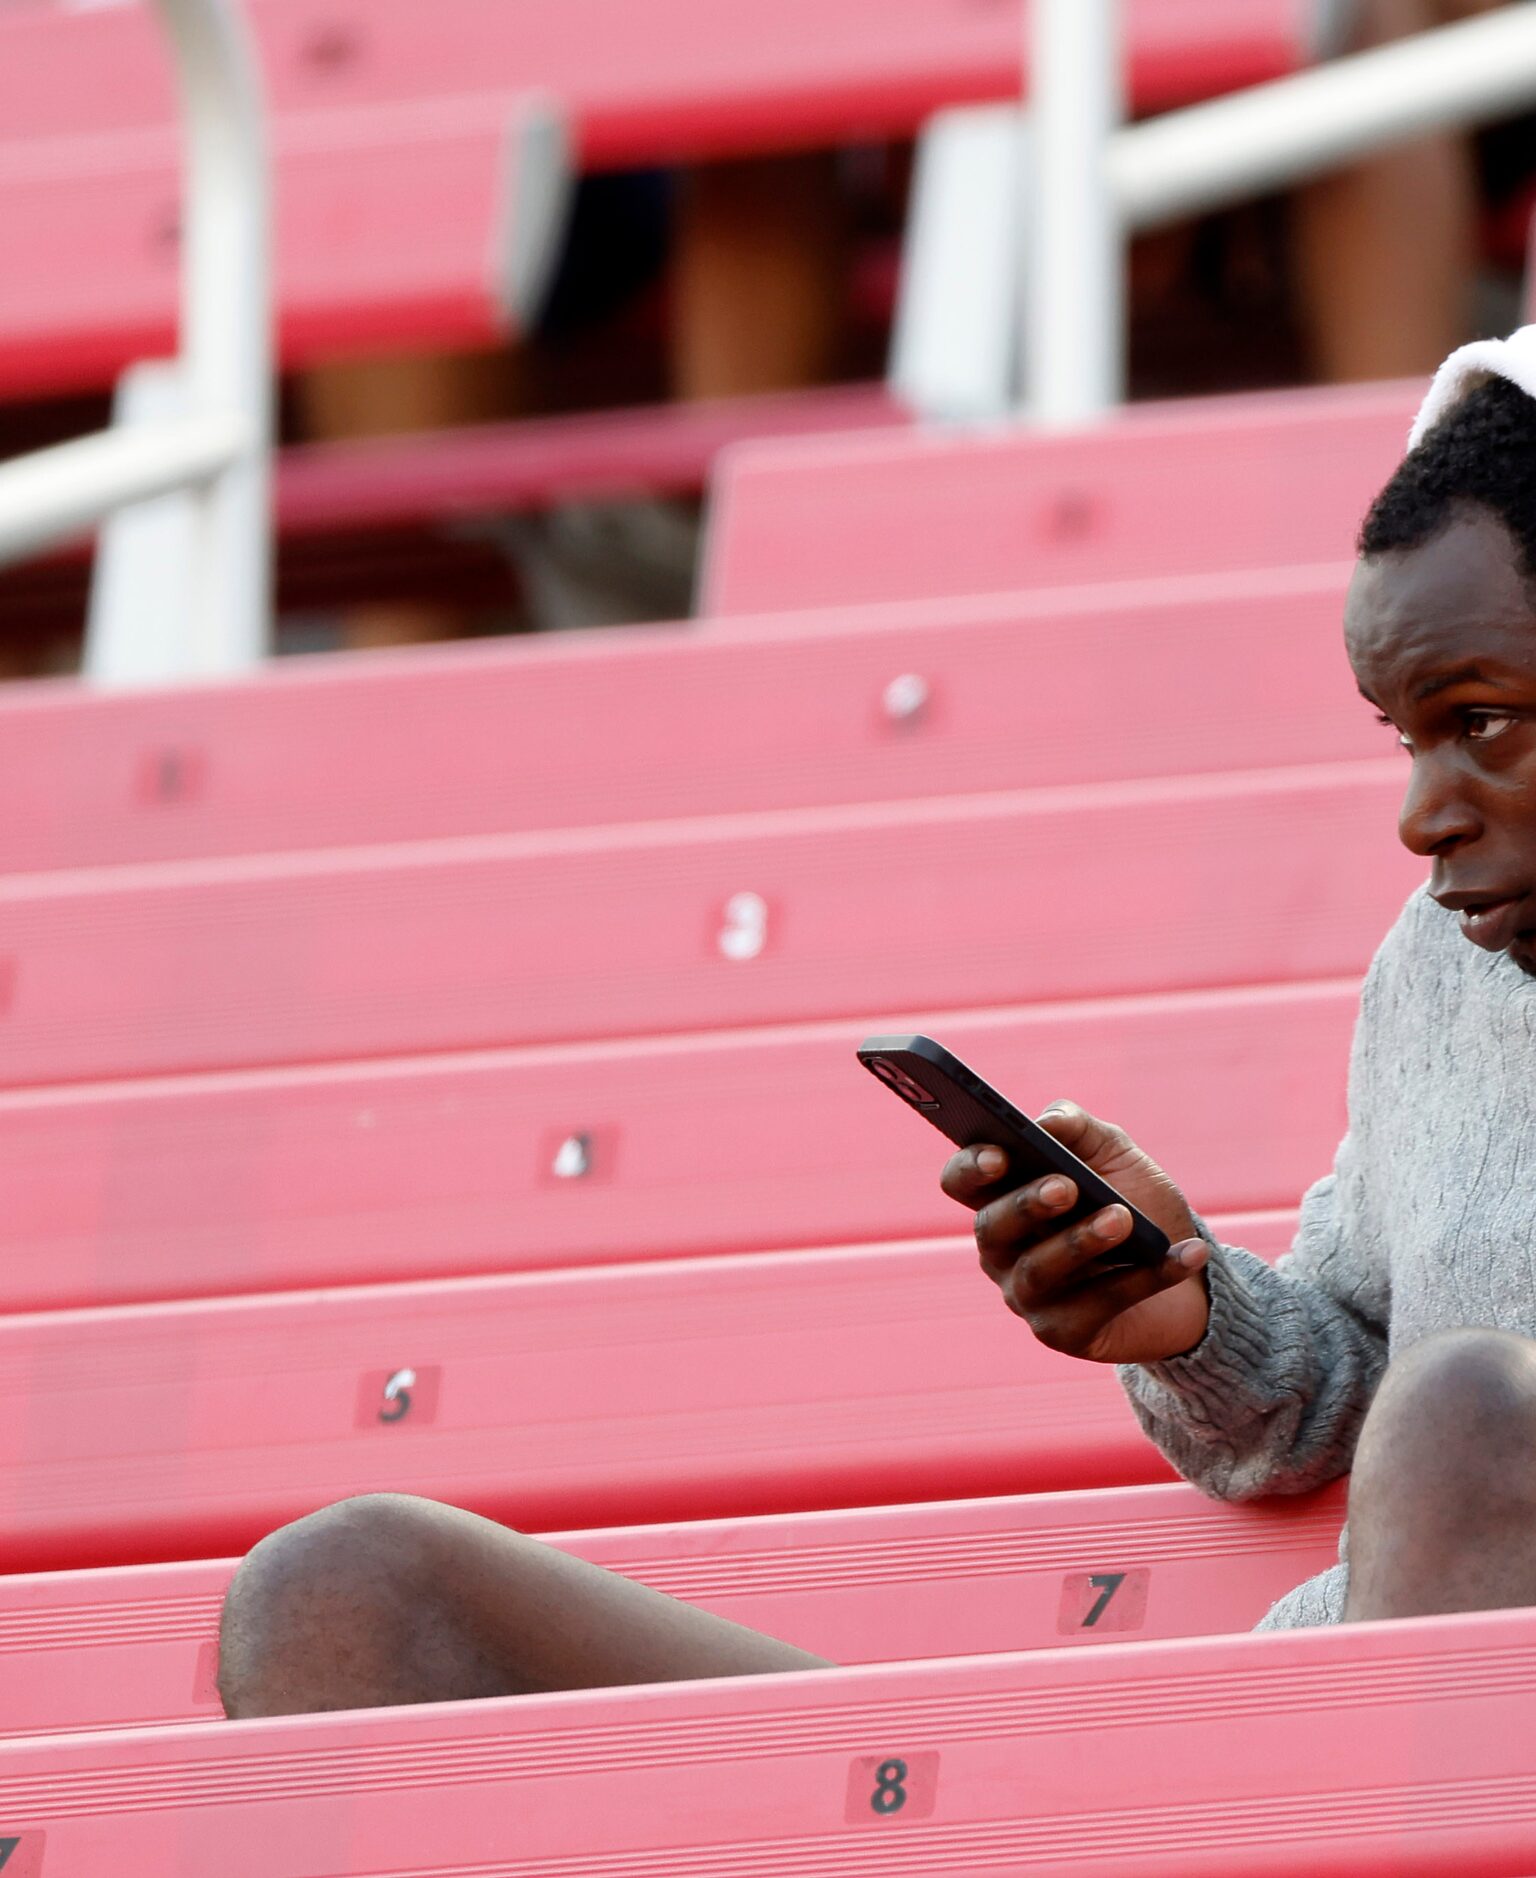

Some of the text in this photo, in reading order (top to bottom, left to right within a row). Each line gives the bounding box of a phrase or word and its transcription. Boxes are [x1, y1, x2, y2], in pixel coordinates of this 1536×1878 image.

[720, 891, 768, 960] 3
[377, 1368, 416, 1427] 5
[1080, 1572, 1128, 1628] 7
[870, 1758, 907, 1815] 8
